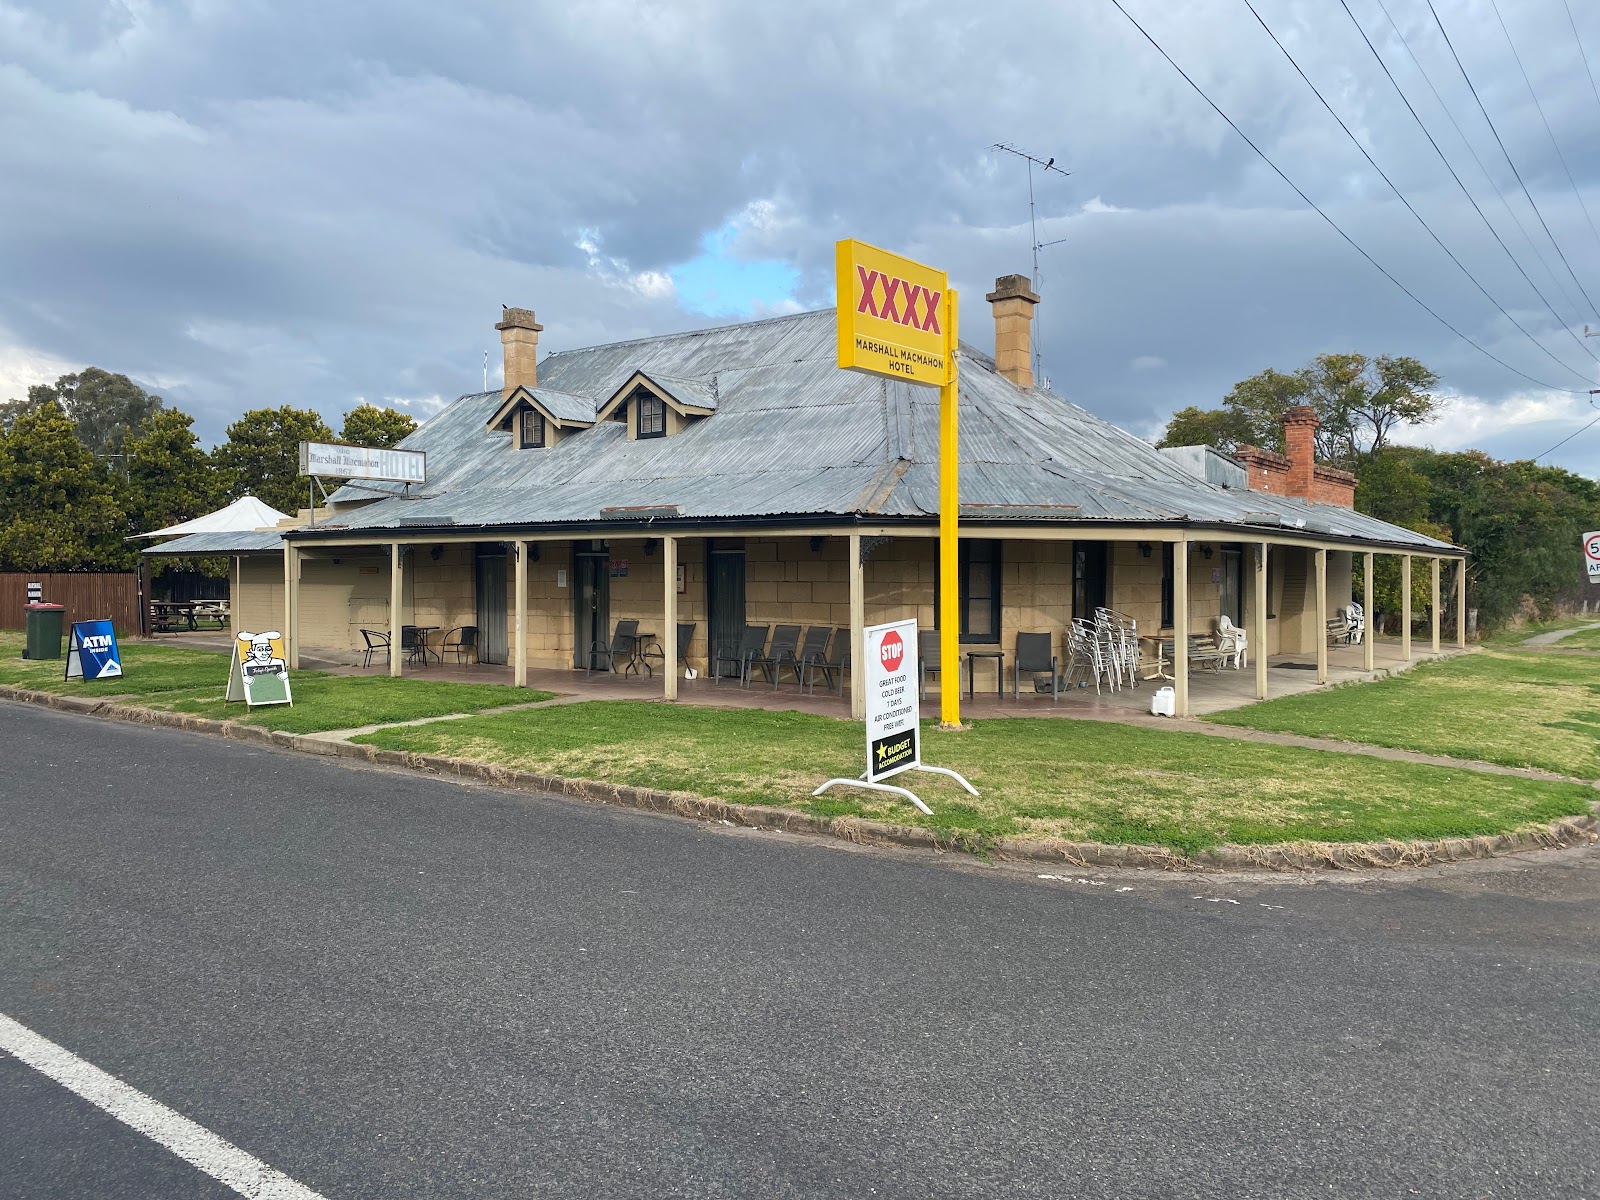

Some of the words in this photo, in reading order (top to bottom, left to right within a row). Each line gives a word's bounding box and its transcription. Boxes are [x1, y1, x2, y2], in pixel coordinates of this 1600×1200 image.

[856, 264, 942, 336] XXXX
[856, 338, 899, 358] MARSHALL
[900, 349, 944, 369] MACMAHON
[889, 360, 914, 375] HOTEL
[309, 452, 341, 465] Marshall
[380, 451, 422, 479] HOTEL
[1590, 543, 1600, 554] 5
[83, 635, 112, 648] ATM
[881, 642, 902, 661] STOP
[879, 678, 894, 688] GREAT
[895, 674, 907, 683] FOOD
[881, 689, 894, 698] COLD
[895, 686, 905, 695] BEER
[891, 698, 902, 707] DAYS
[874, 714, 882, 723] AIR
[882, 705, 912, 720] CONDITIONED
[883, 722, 894, 731] FREE
[887, 738, 910, 756] BUDGET
